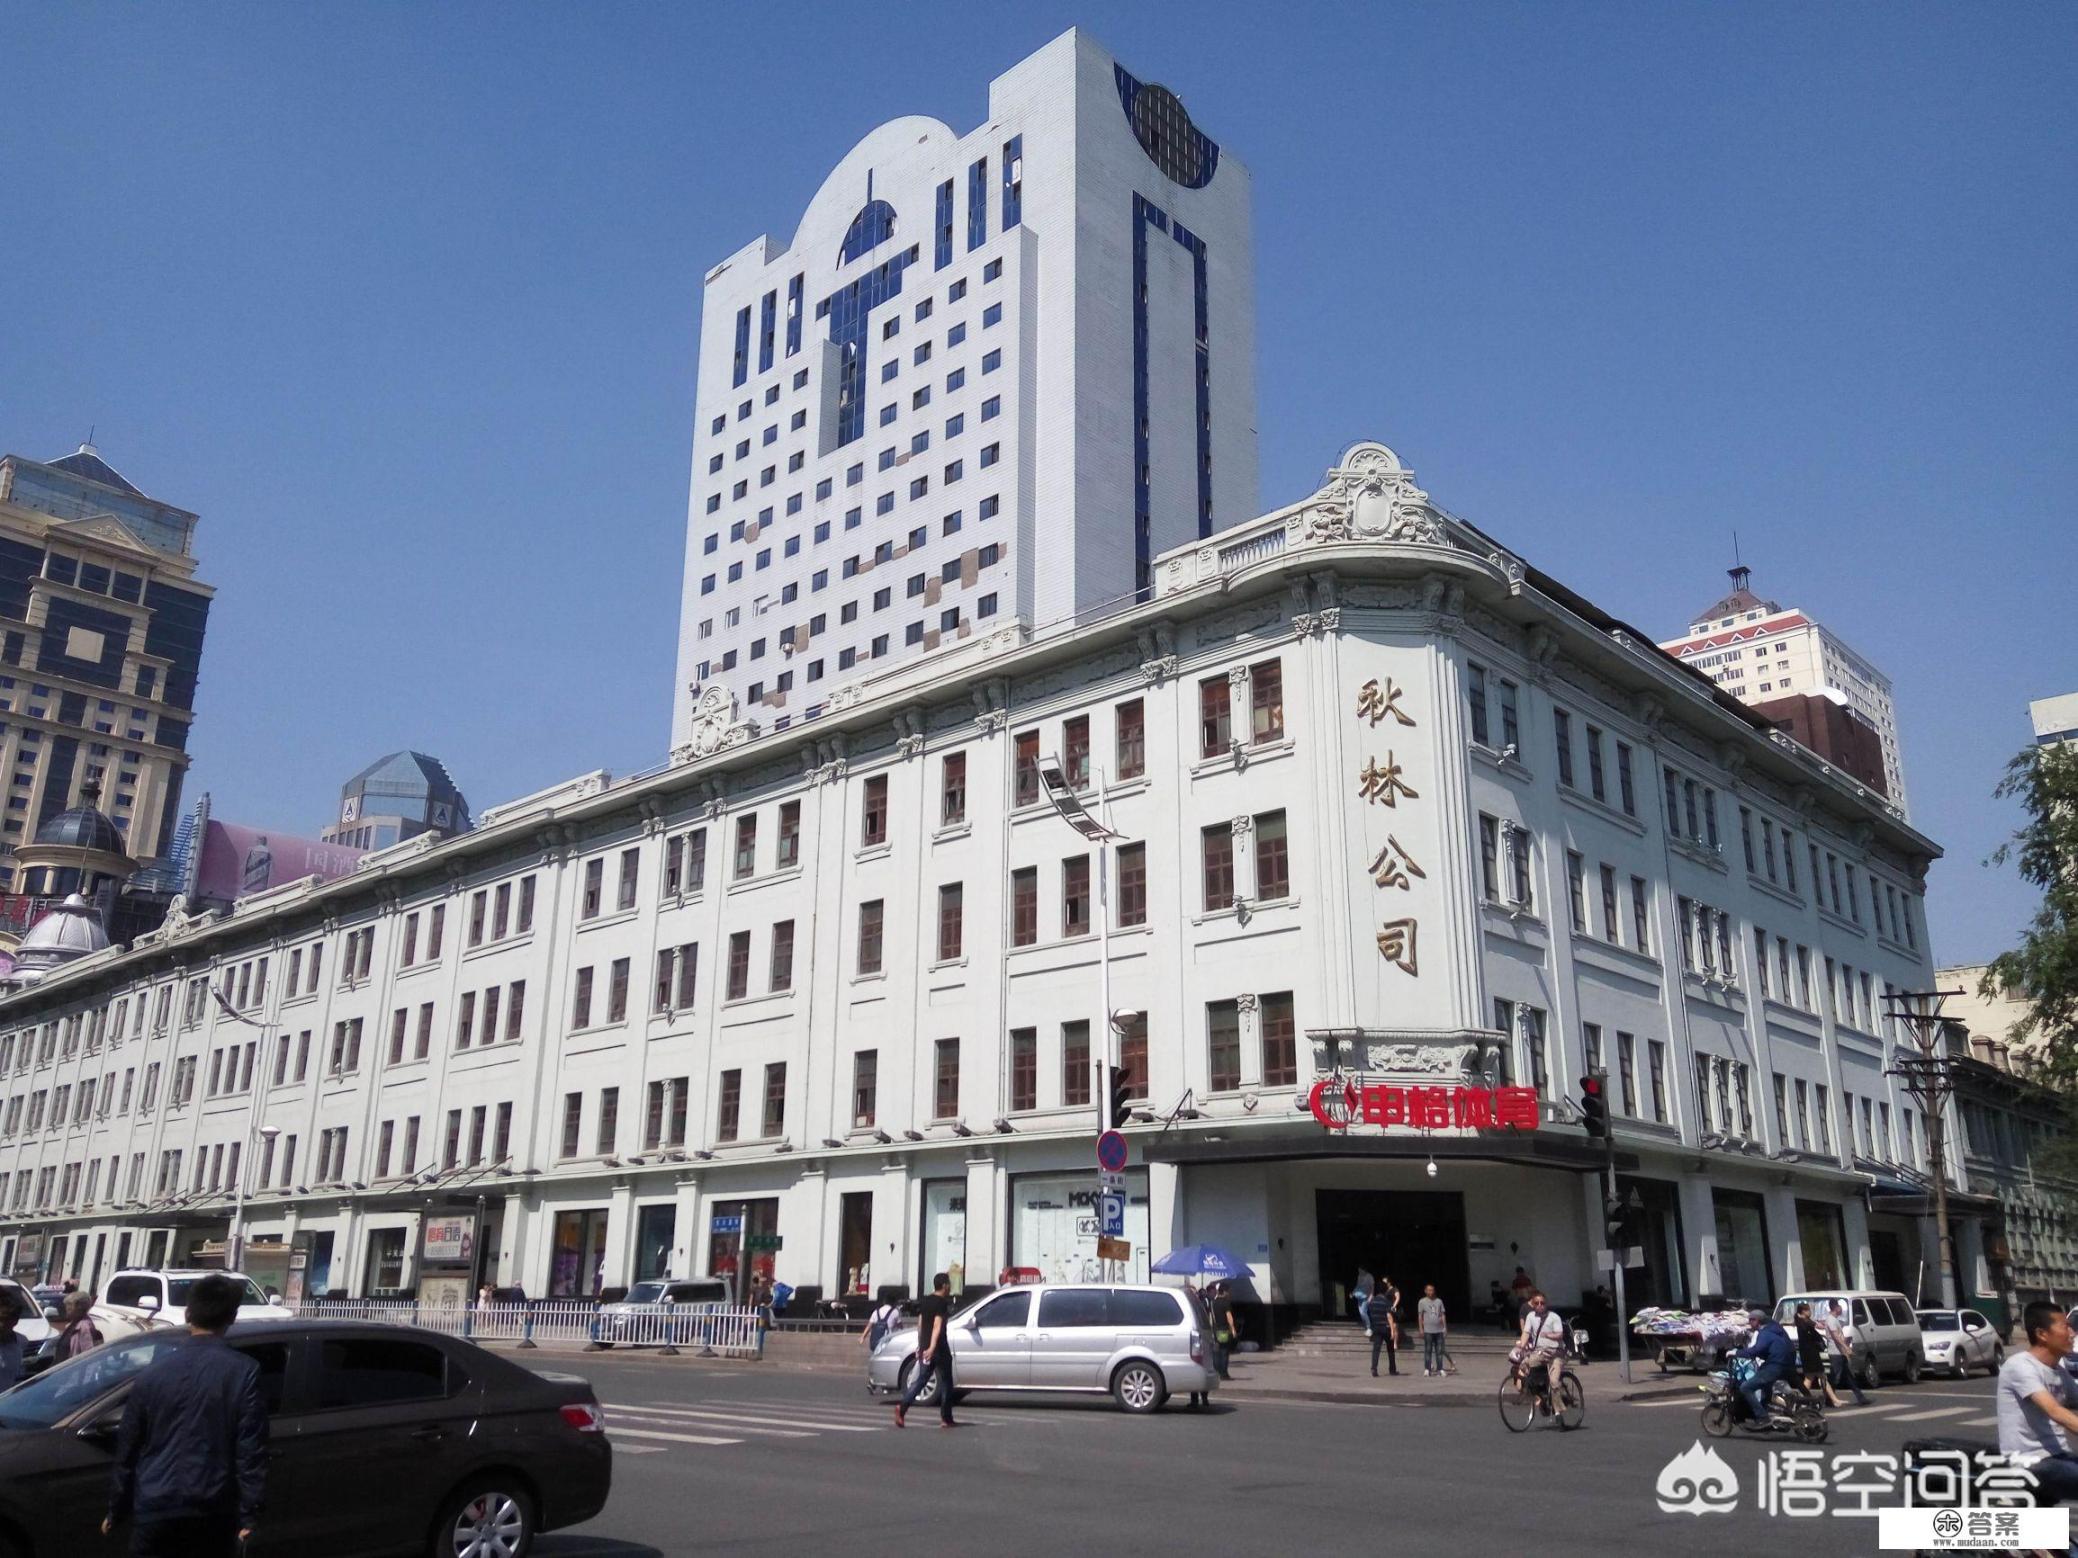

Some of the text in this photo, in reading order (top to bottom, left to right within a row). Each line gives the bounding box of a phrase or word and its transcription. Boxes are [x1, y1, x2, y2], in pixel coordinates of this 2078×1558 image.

[1356, 676, 1427, 977] 秋林公司
[1361, 1085, 1540, 1129] 申格体育
[1103, 1197, 1121, 1231] P
